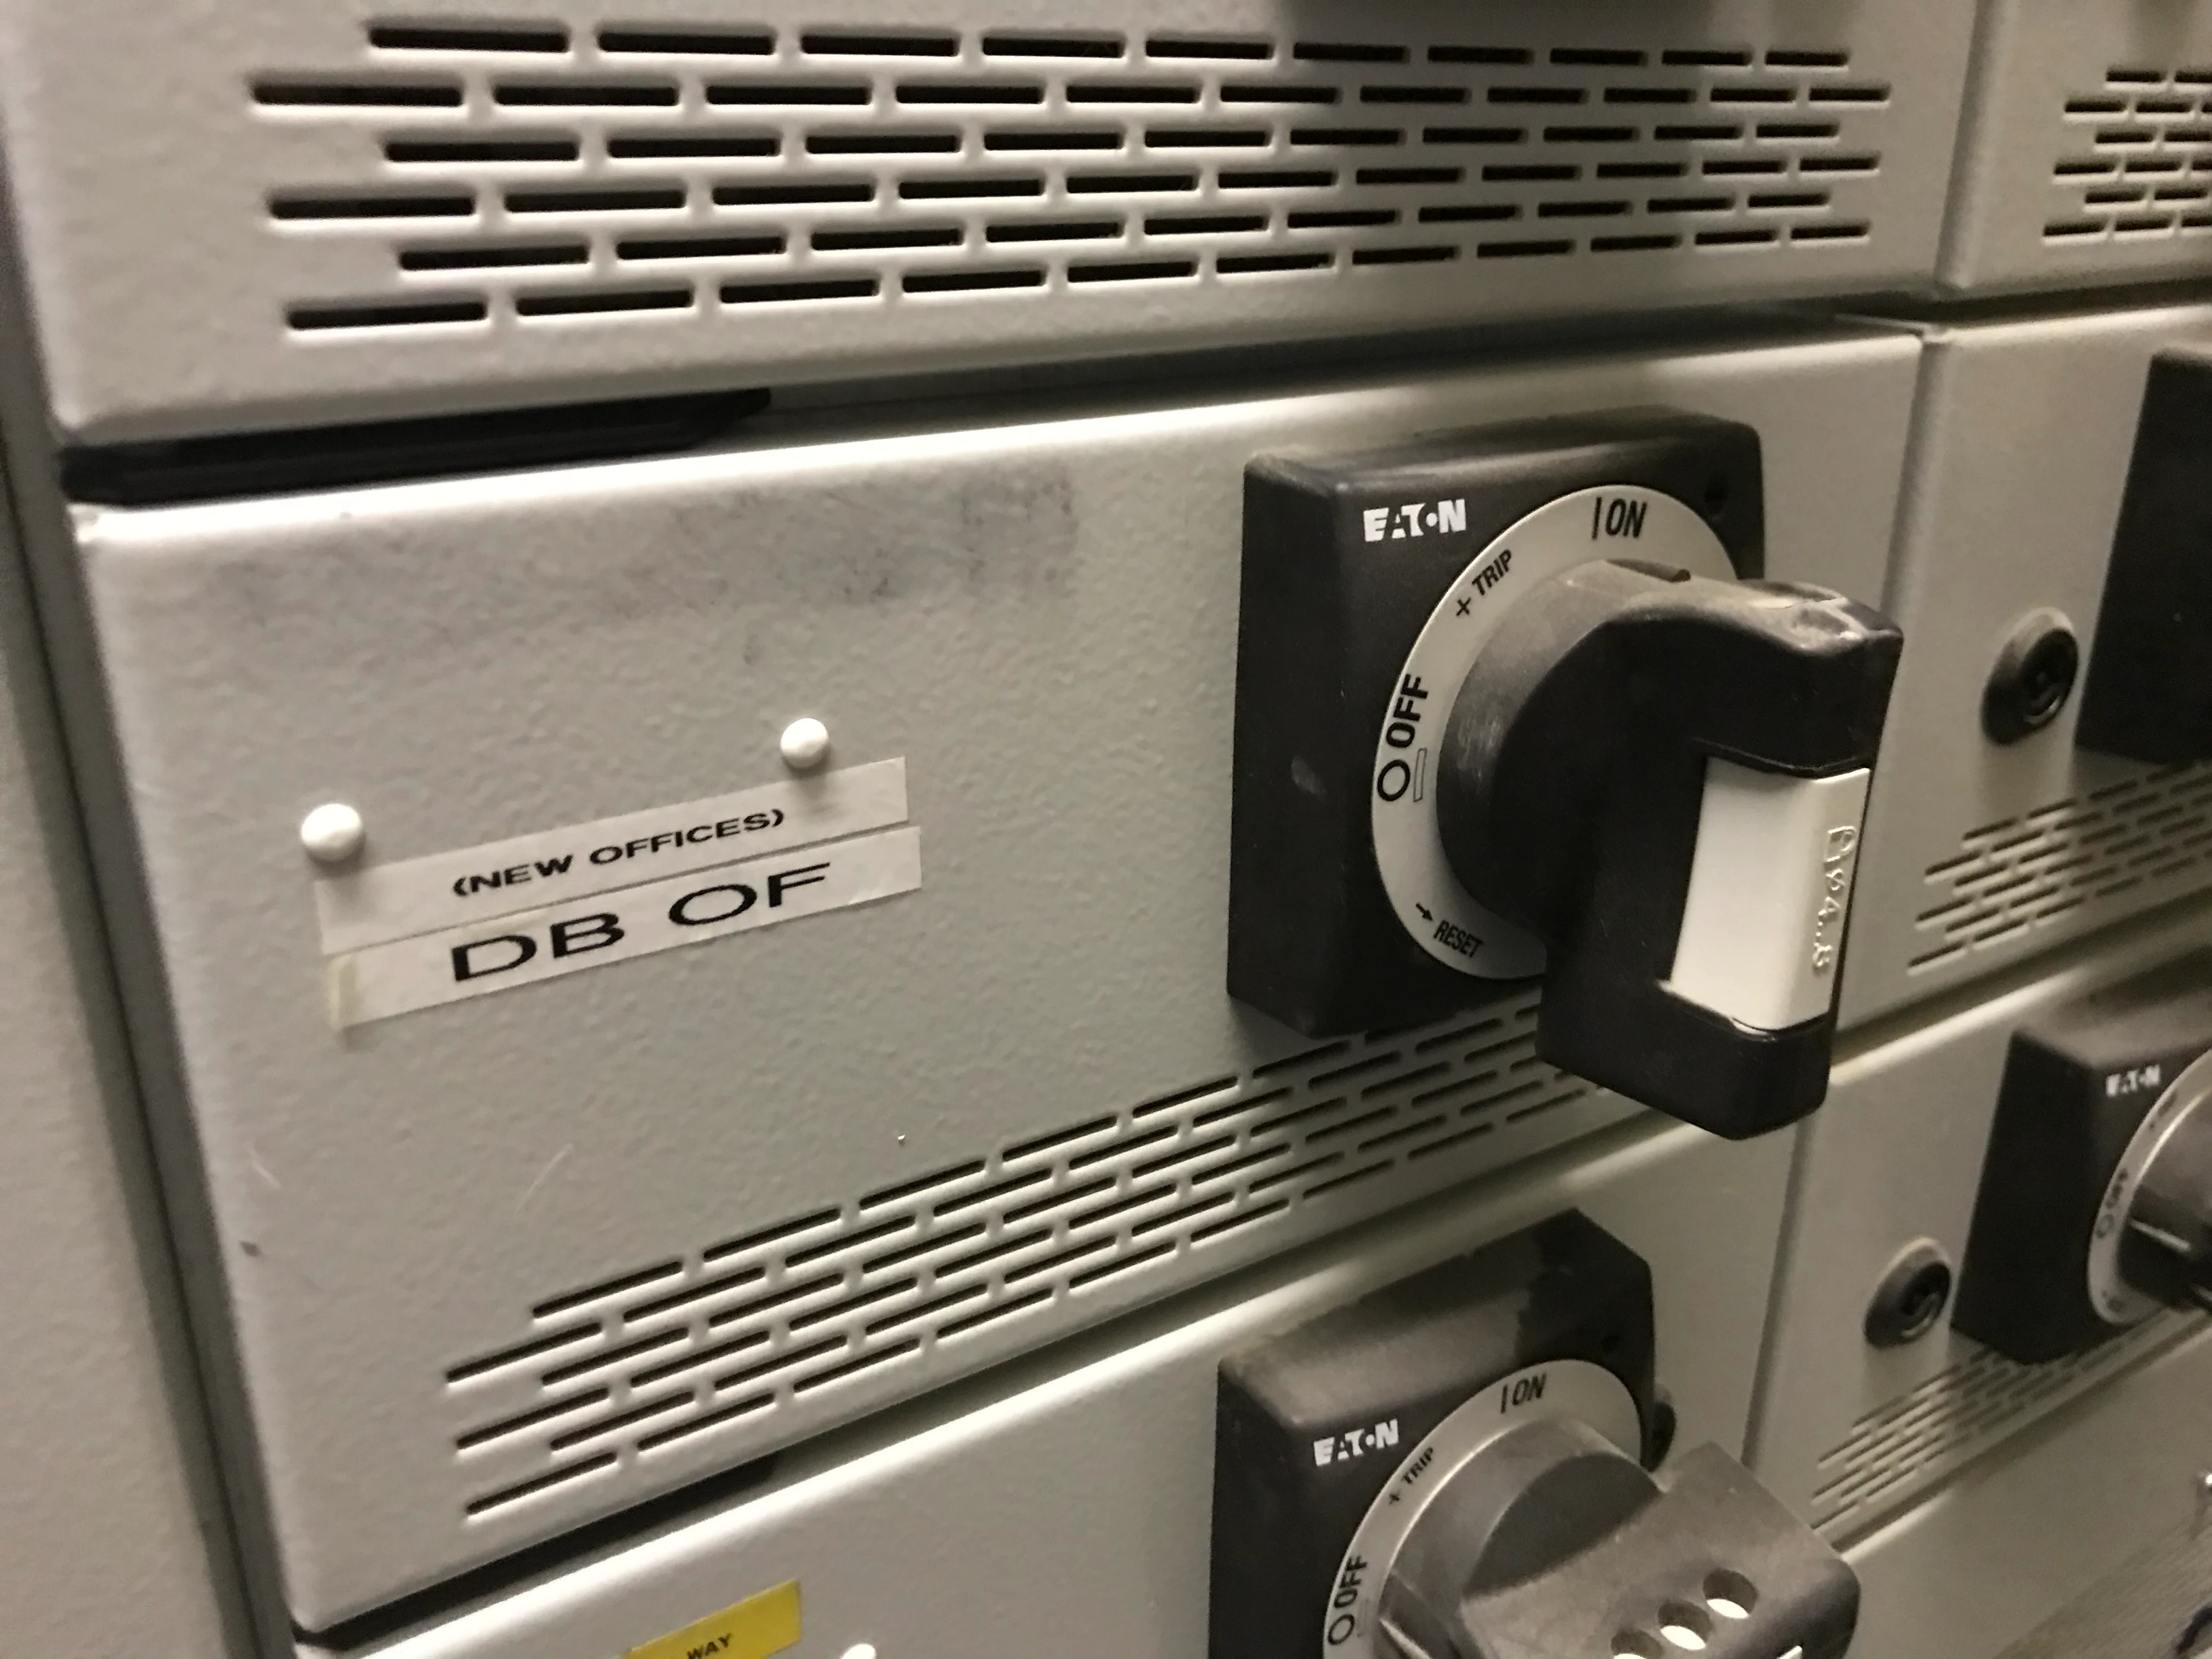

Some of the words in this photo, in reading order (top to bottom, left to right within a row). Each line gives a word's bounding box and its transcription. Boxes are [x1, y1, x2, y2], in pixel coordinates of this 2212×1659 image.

[1605, 500, 1647, 539] ON
[1471, 549, 1513, 596] TRIP
[1386, 673, 1429, 749] OFF
[452, 854, 574, 898] (NEW
[590, 808, 785, 866] OFFICES)
[451, 911, 625, 982] DB
[667, 861, 831, 927] OF
[1433, 919, 1483, 959] RESET
[1512, 1373, 1547, 1406] ON
[1401, 1447, 1434, 1486] TRIP
[1334, 1554, 1368, 1610] OFF
[686, 1632, 732, 1659] WAY
